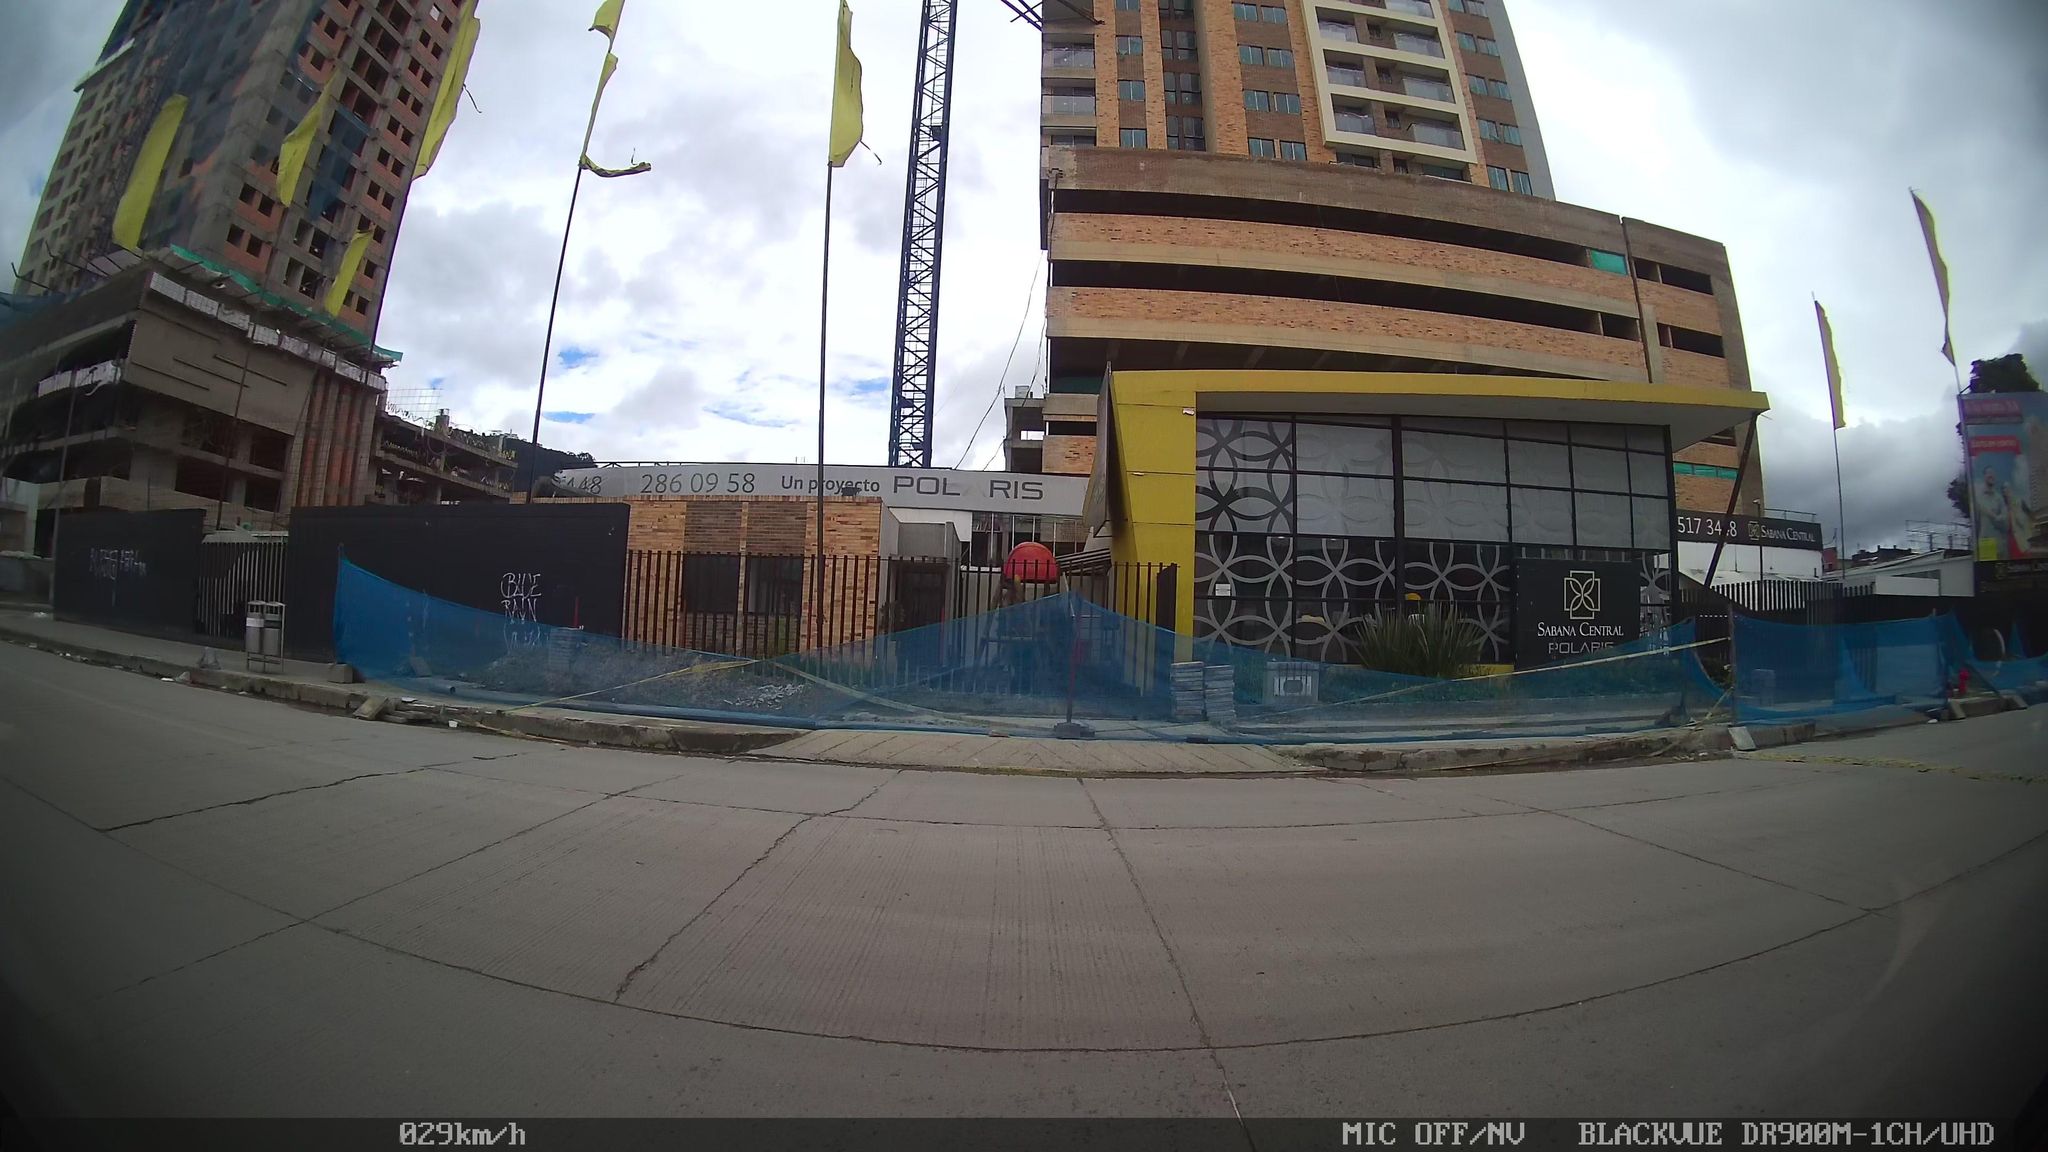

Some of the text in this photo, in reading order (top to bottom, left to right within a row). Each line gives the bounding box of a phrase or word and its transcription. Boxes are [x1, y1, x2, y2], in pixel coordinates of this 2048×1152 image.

[640, 473, 682, 494] 286
[690, 473, 719, 493] 09
[726, 473, 755, 494] 58
[782, 475, 803, 490] Un
[808, 478, 880, 494] poyecto
[1677, 516, 1738, 537] 517 34 8
[1537, 622, 1624, 637] SABANA CENTRAL
